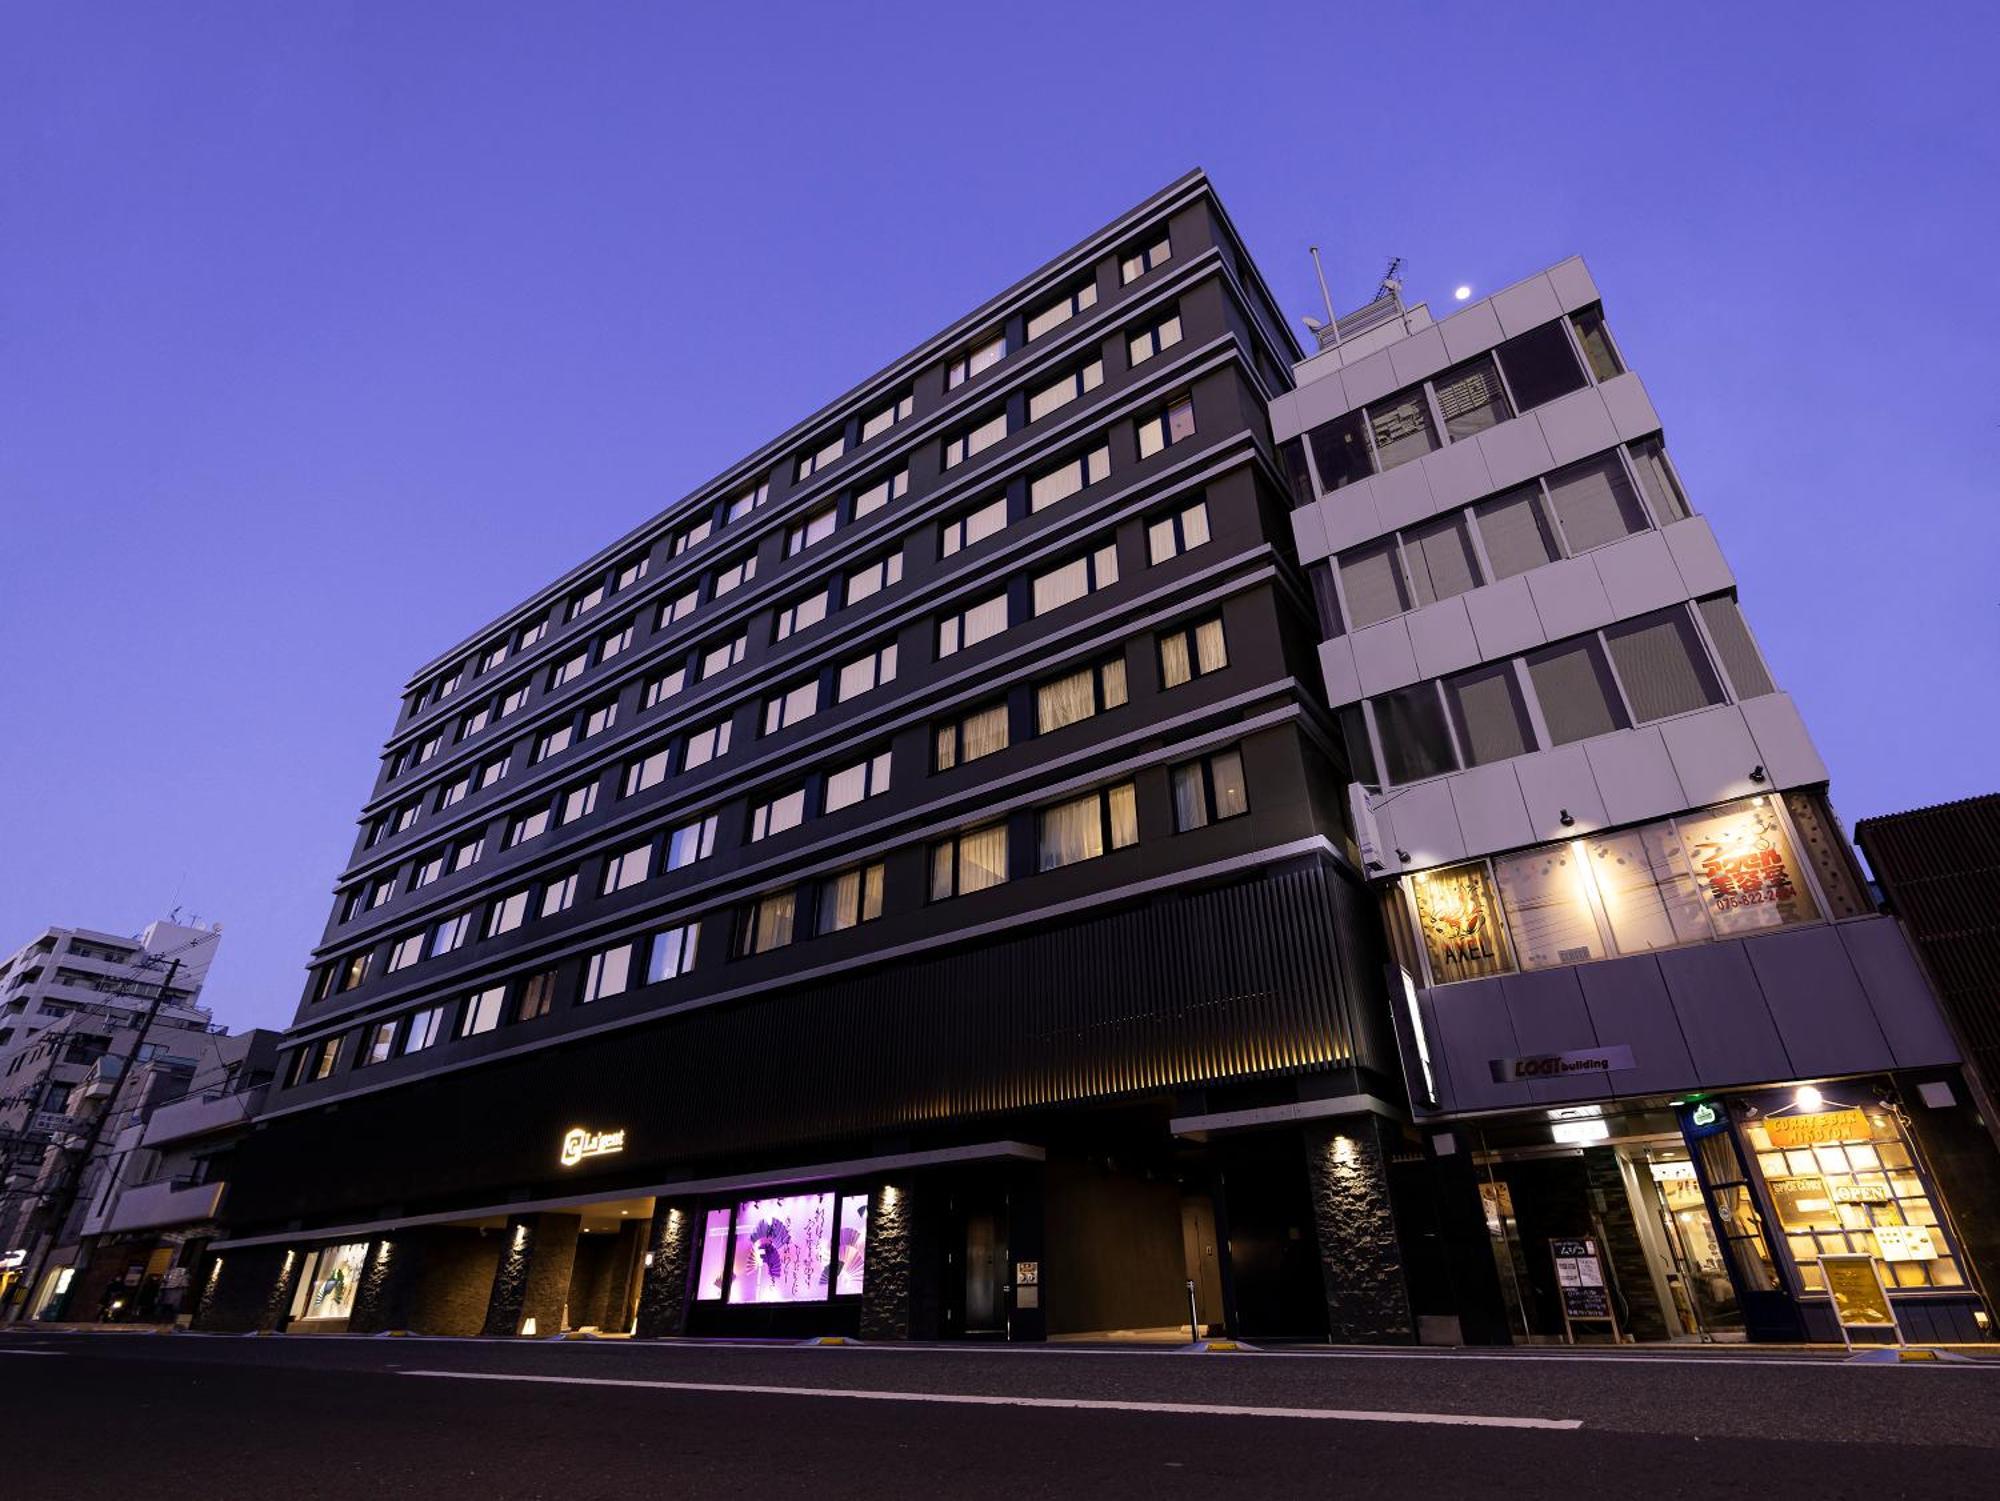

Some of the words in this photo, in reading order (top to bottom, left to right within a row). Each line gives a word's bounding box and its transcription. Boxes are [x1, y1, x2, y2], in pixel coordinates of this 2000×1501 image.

[1709, 866, 1792, 899] 美容室
[1440, 937, 1495, 964] AXEL
[1561, 1059, 1609, 1071] building
[1838, 1186, 1886, 1200] OPEN
